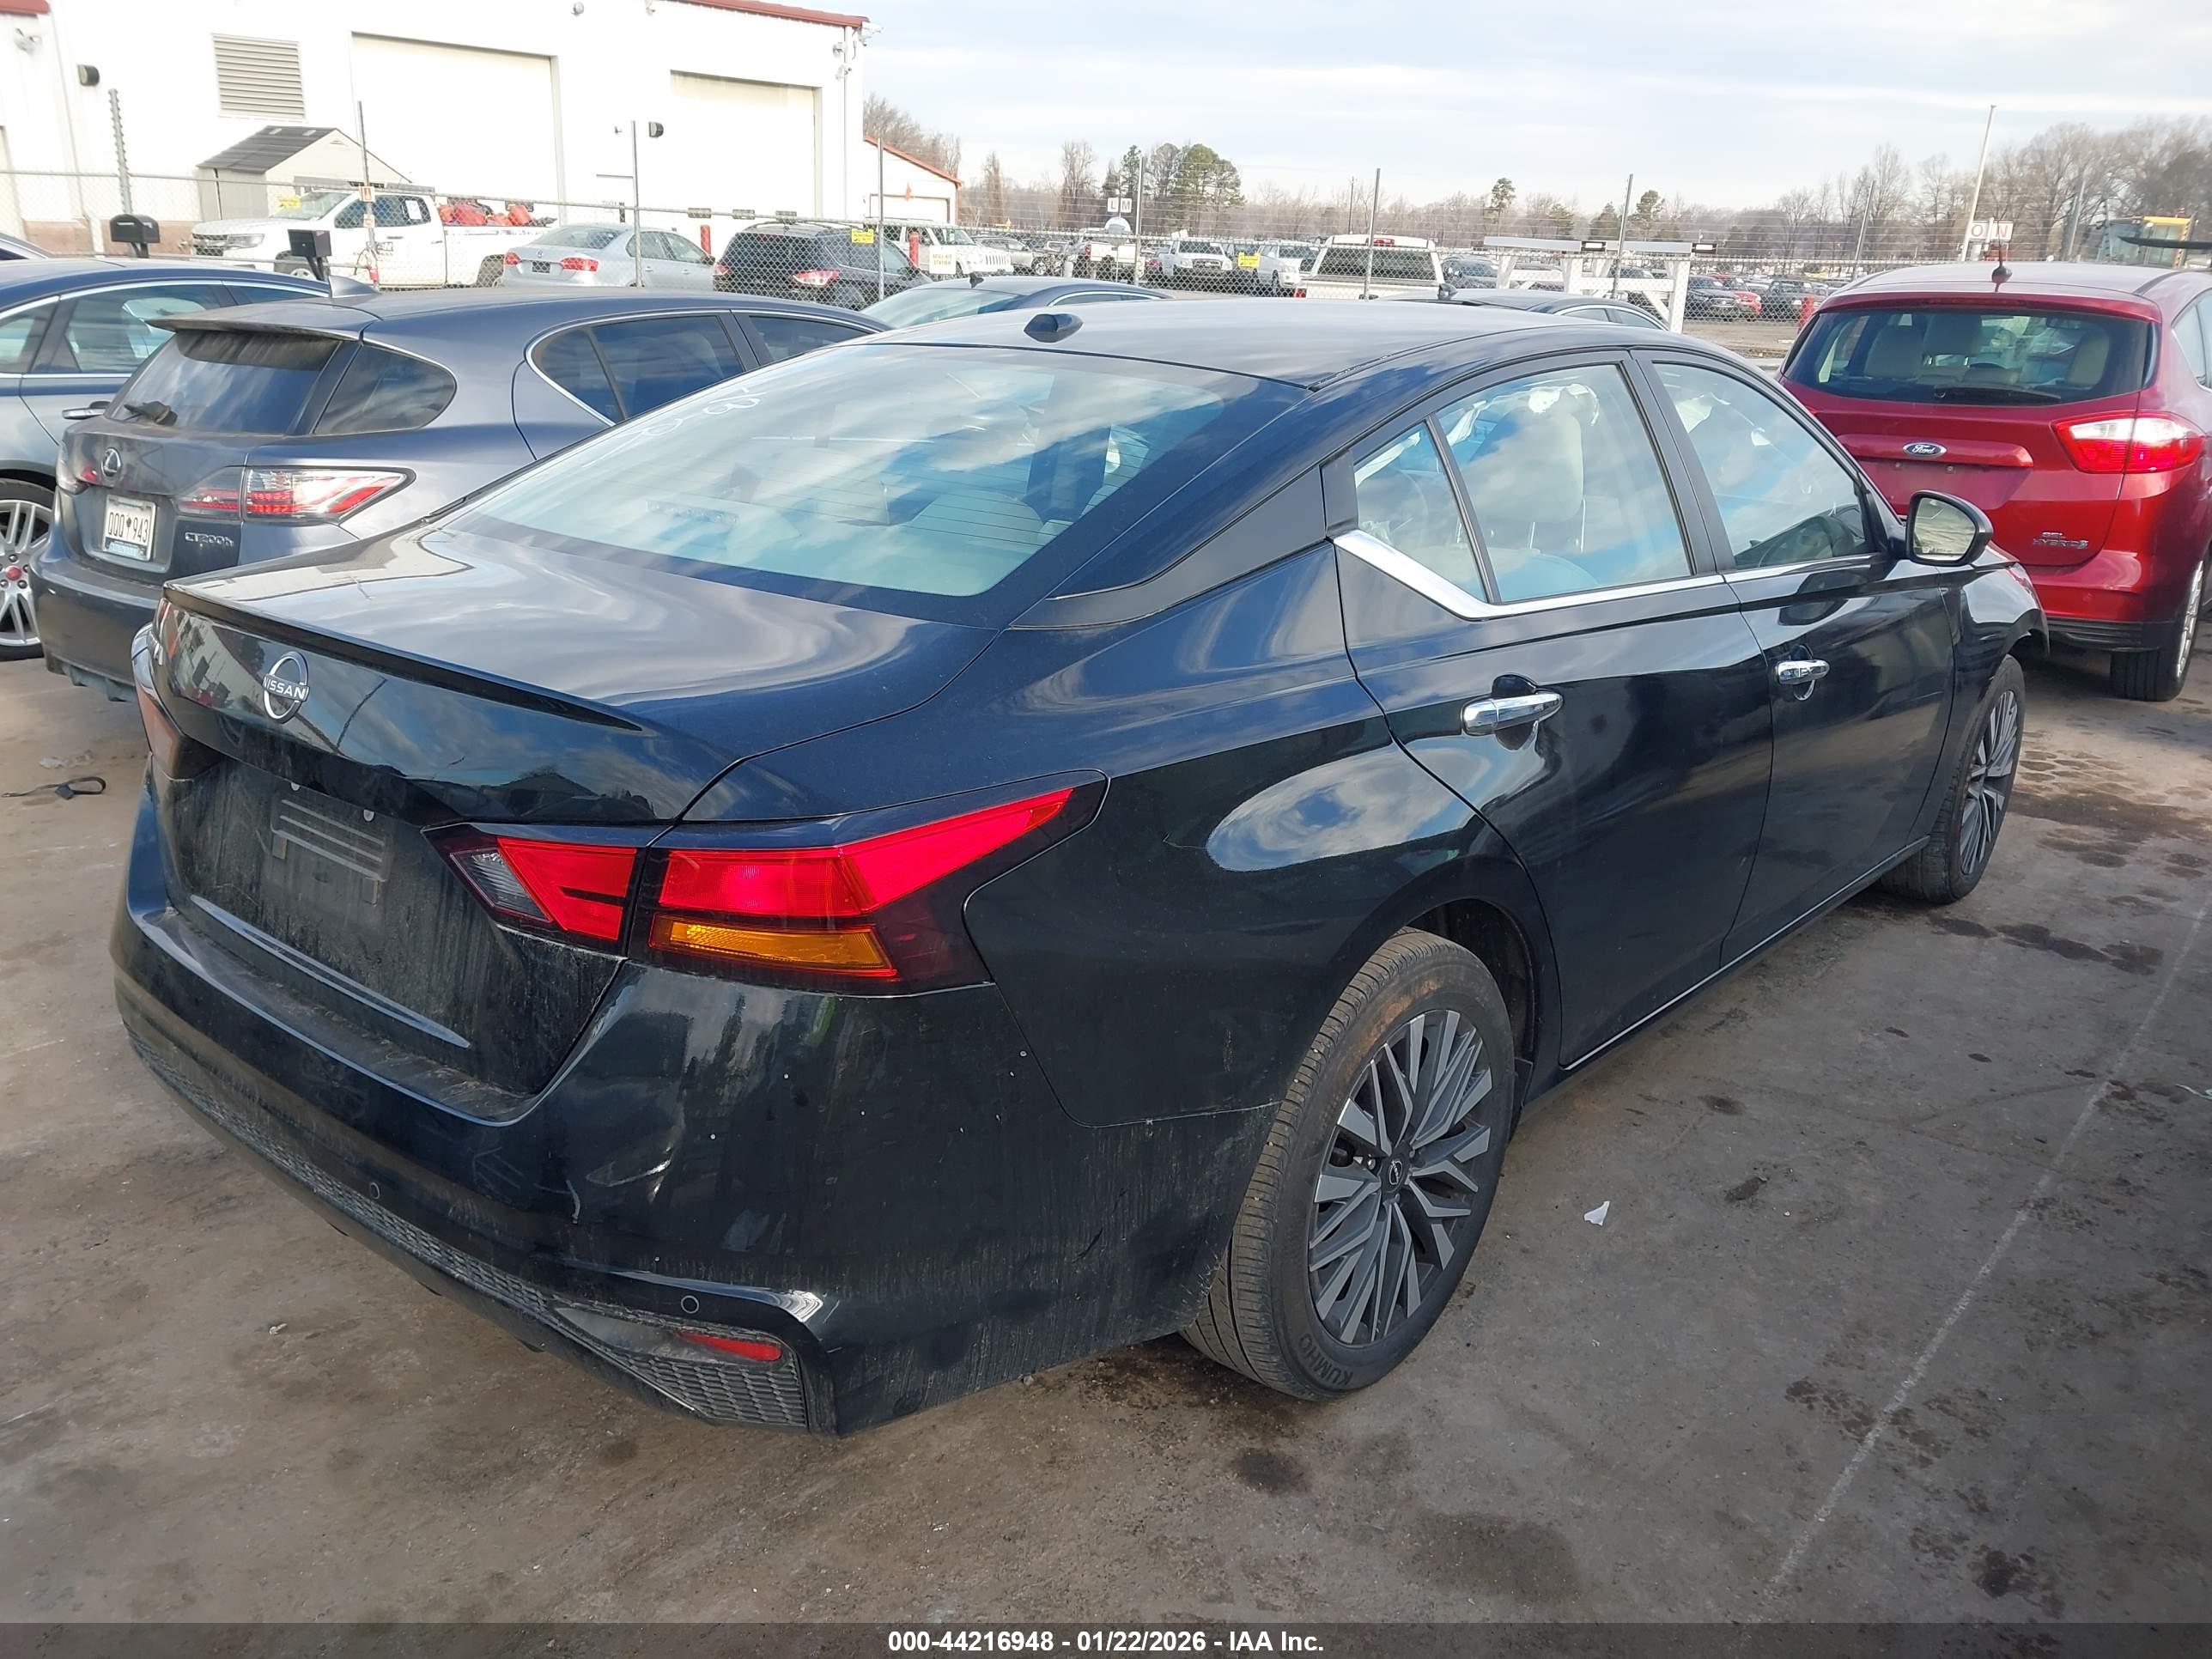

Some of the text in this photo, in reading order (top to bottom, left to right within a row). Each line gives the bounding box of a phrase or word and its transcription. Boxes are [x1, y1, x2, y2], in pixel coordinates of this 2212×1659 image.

[1121, 200, 1130, 210] M
[1971, 224, 1984, 237] O
[133, 517, 149, 543] 943
[263, 677, 306, 700] NISSAN
[1298, 1333, 1354, 1386] KUMHO
